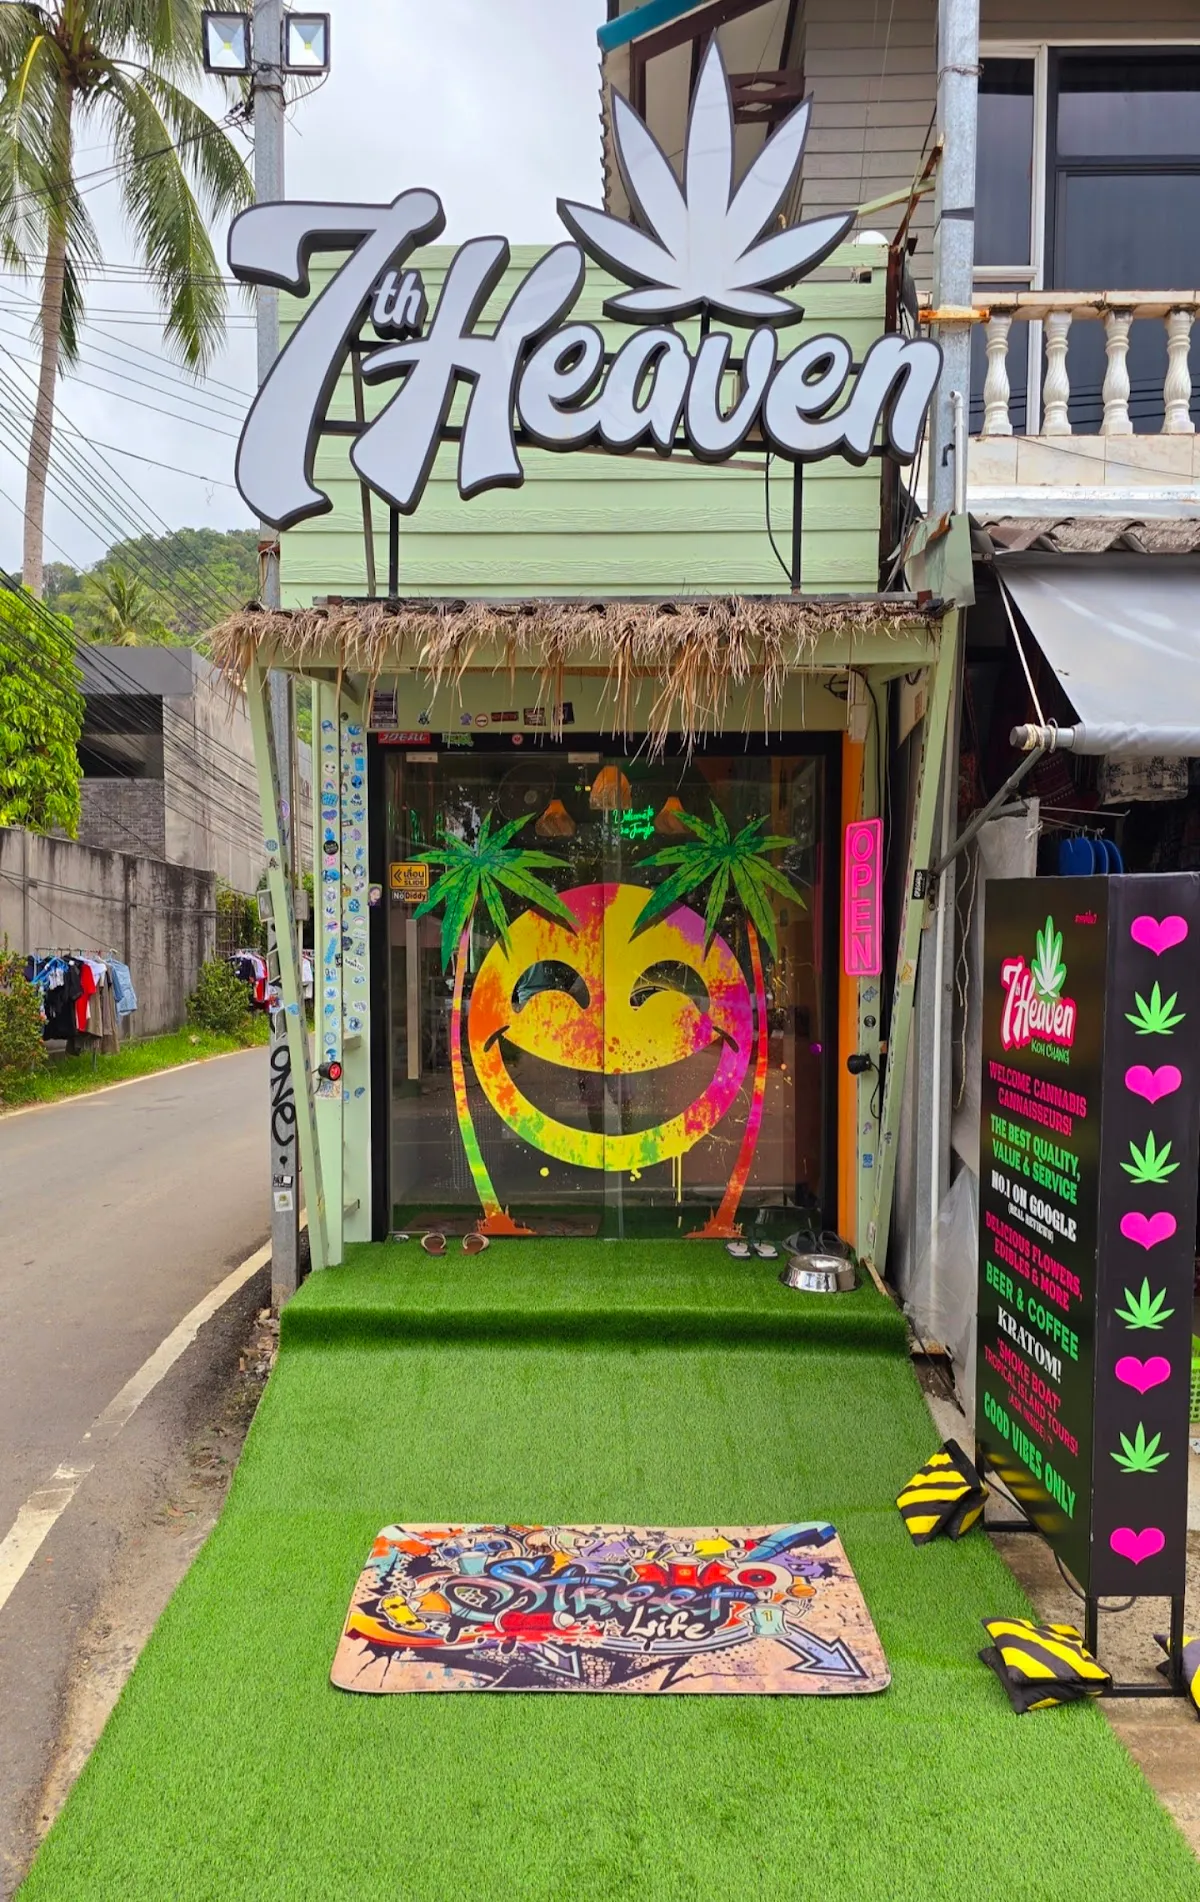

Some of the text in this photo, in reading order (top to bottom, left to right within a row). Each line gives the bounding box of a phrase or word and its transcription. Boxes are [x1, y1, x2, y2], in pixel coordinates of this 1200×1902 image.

[350, 234, 944, 516] Heaven
[393, 891, 427, 901] No Diddy
[850, 826, 874, 970] OPEN
[1012, 974, 1075, 1043] Heaven
[989, 1060, 1087, 1119] WELCOME CANNABIS
[1031, 1039, 1070, 1066] KOH CHANG
[990, 1113, 1081, 1182] THE BEST QUALITY,
[998, 1086, 1072, 1138] CANNAISSEURS!
[991, 1168, 1077, 1243] NO.1 ON GOOGLE
[992, 1137, 1078, 1206] VALUE & SERVICE
[985, 1210, 1083, 1303] DELICIOUS FLOWERS,
[994, 1236, 1030, 1280] EDIBLES
[1040, 1272, 1070, 1313] MORE
[986, 1260, 1079, 1362] BEER & COFFEE
[997, 1304, 1062, 1385] KRATOM!
[984, 1344, 1079, 1458] TROPICAL ISLAND TOURS!
[984, 1391, 1076, 1520] GOOD VIBES ONLY
[628, 1600, 716, 1640] Life
